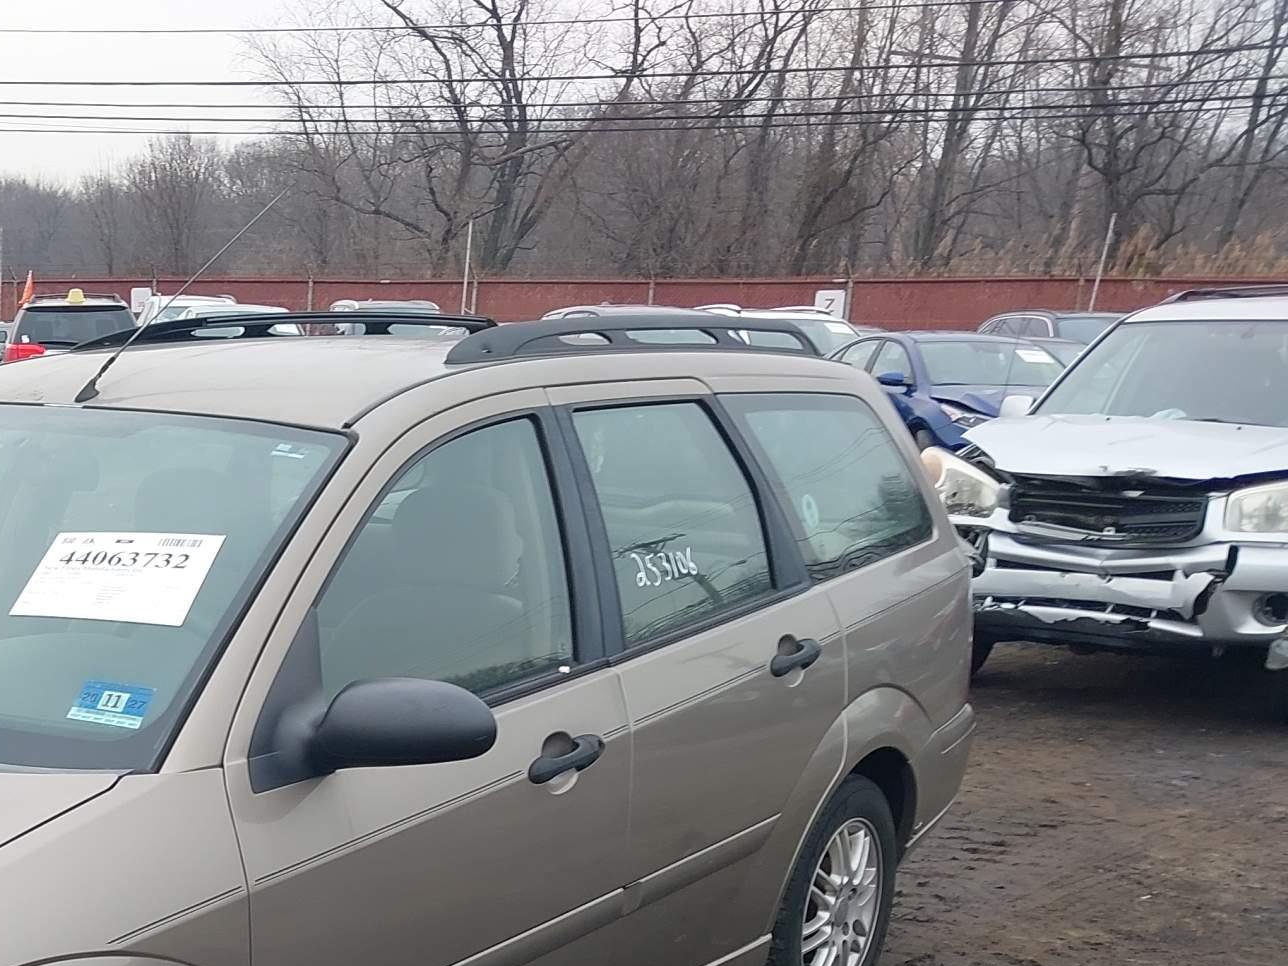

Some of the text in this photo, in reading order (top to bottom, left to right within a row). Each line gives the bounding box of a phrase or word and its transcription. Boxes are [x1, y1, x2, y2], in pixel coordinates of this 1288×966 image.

[59, 550, 190, 569] 44063732
[630, 546, 698, 587] 253106
[102, 693, 123, 709] 11
[127, 699, 147, 710] 27
